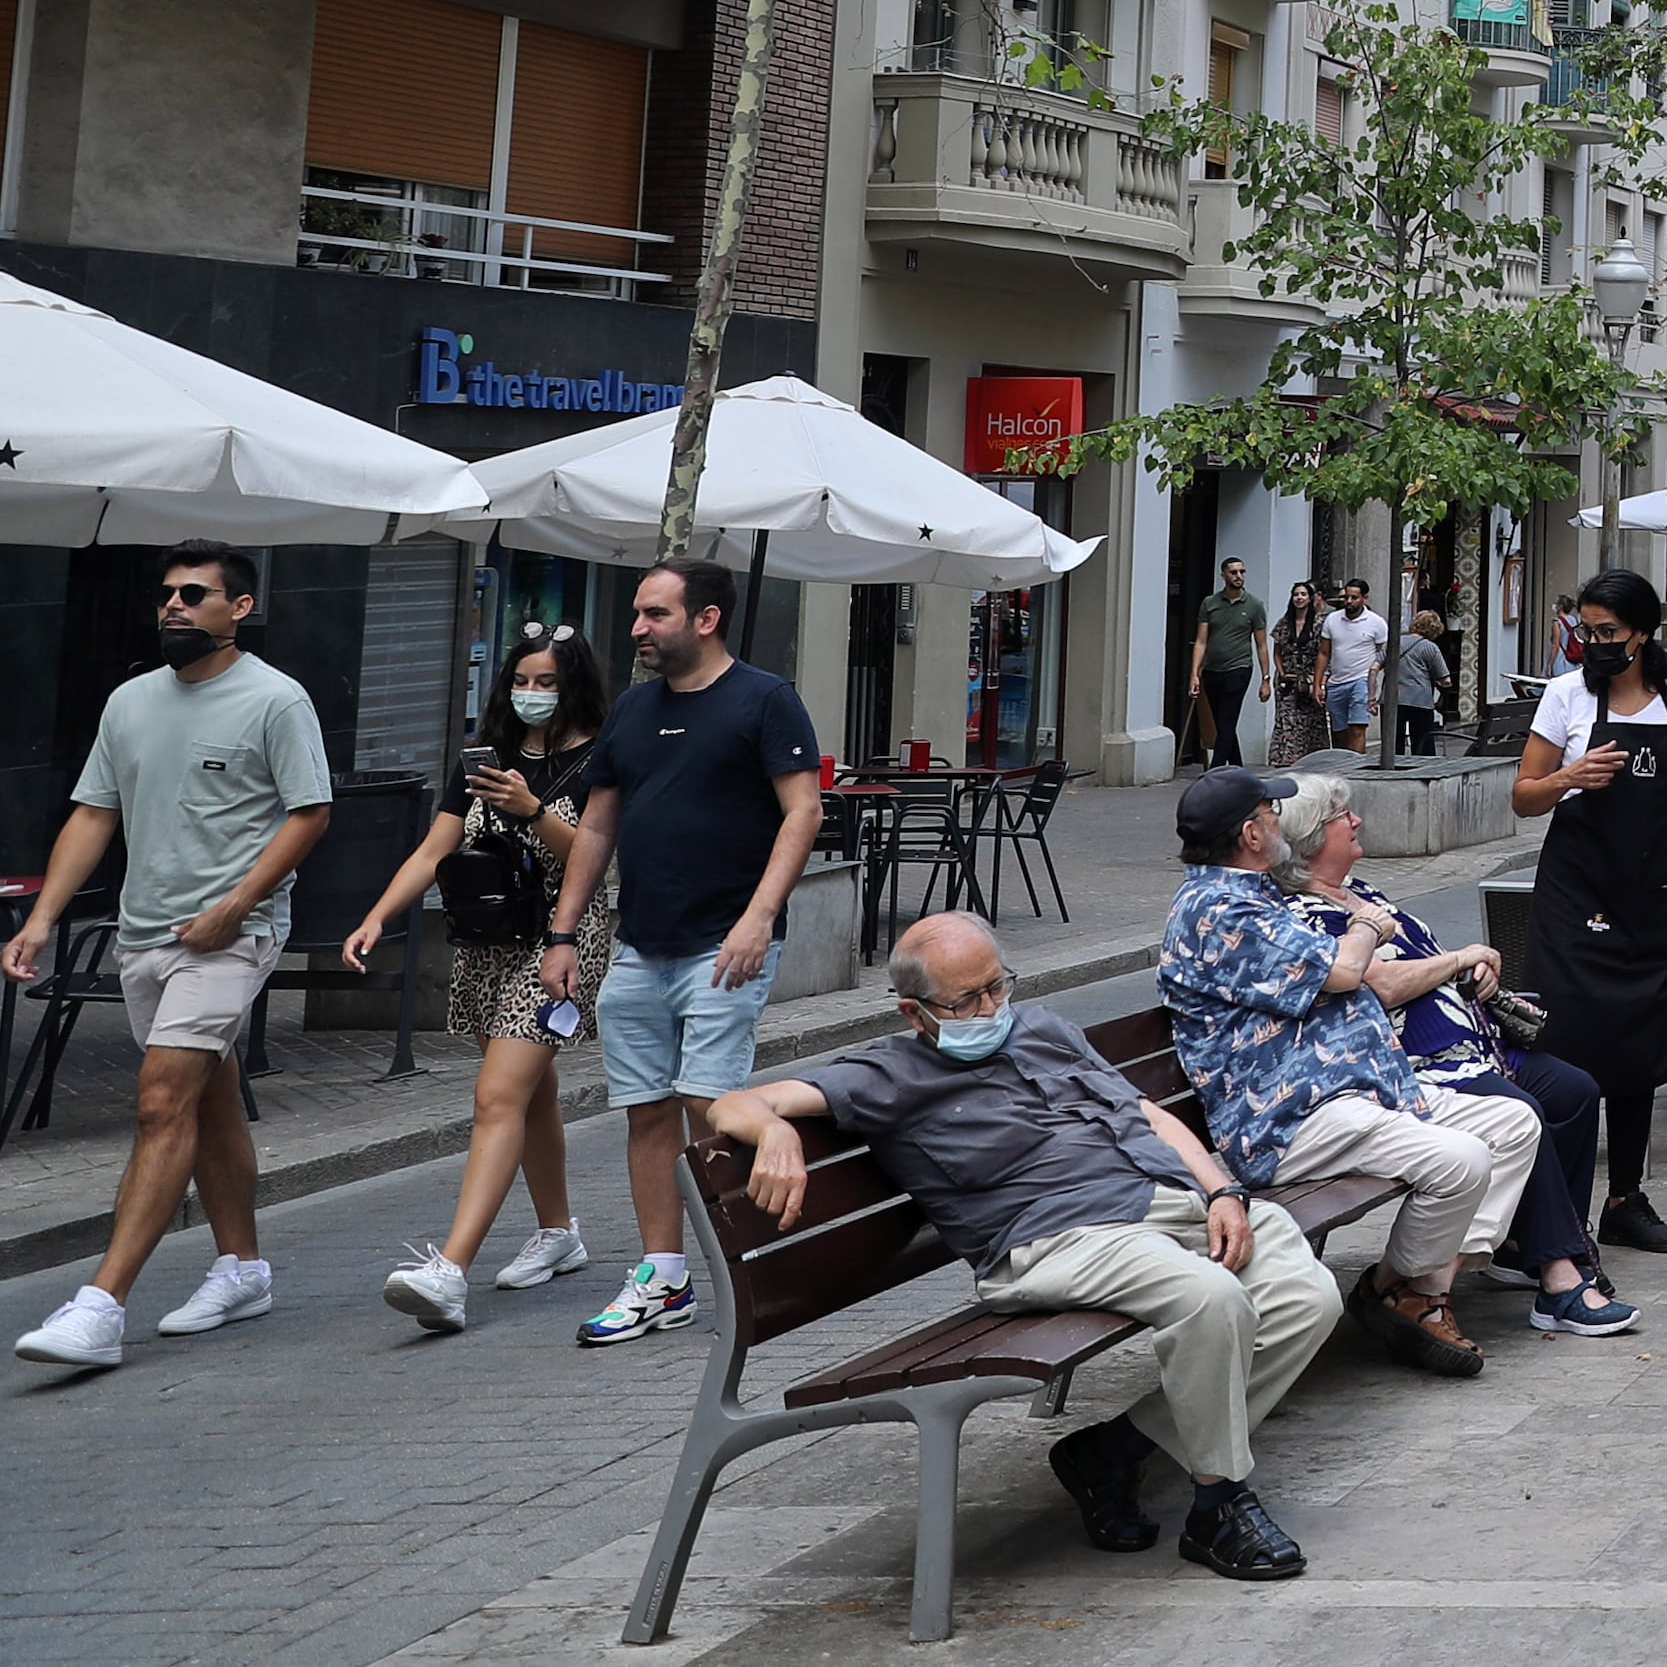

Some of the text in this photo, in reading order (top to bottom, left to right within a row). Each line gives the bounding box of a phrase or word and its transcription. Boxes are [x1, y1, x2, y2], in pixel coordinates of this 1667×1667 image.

[466, 361, 524, 408] the
[524, 368, 612, 412] travel
[614, 369, 686, 414] bran
